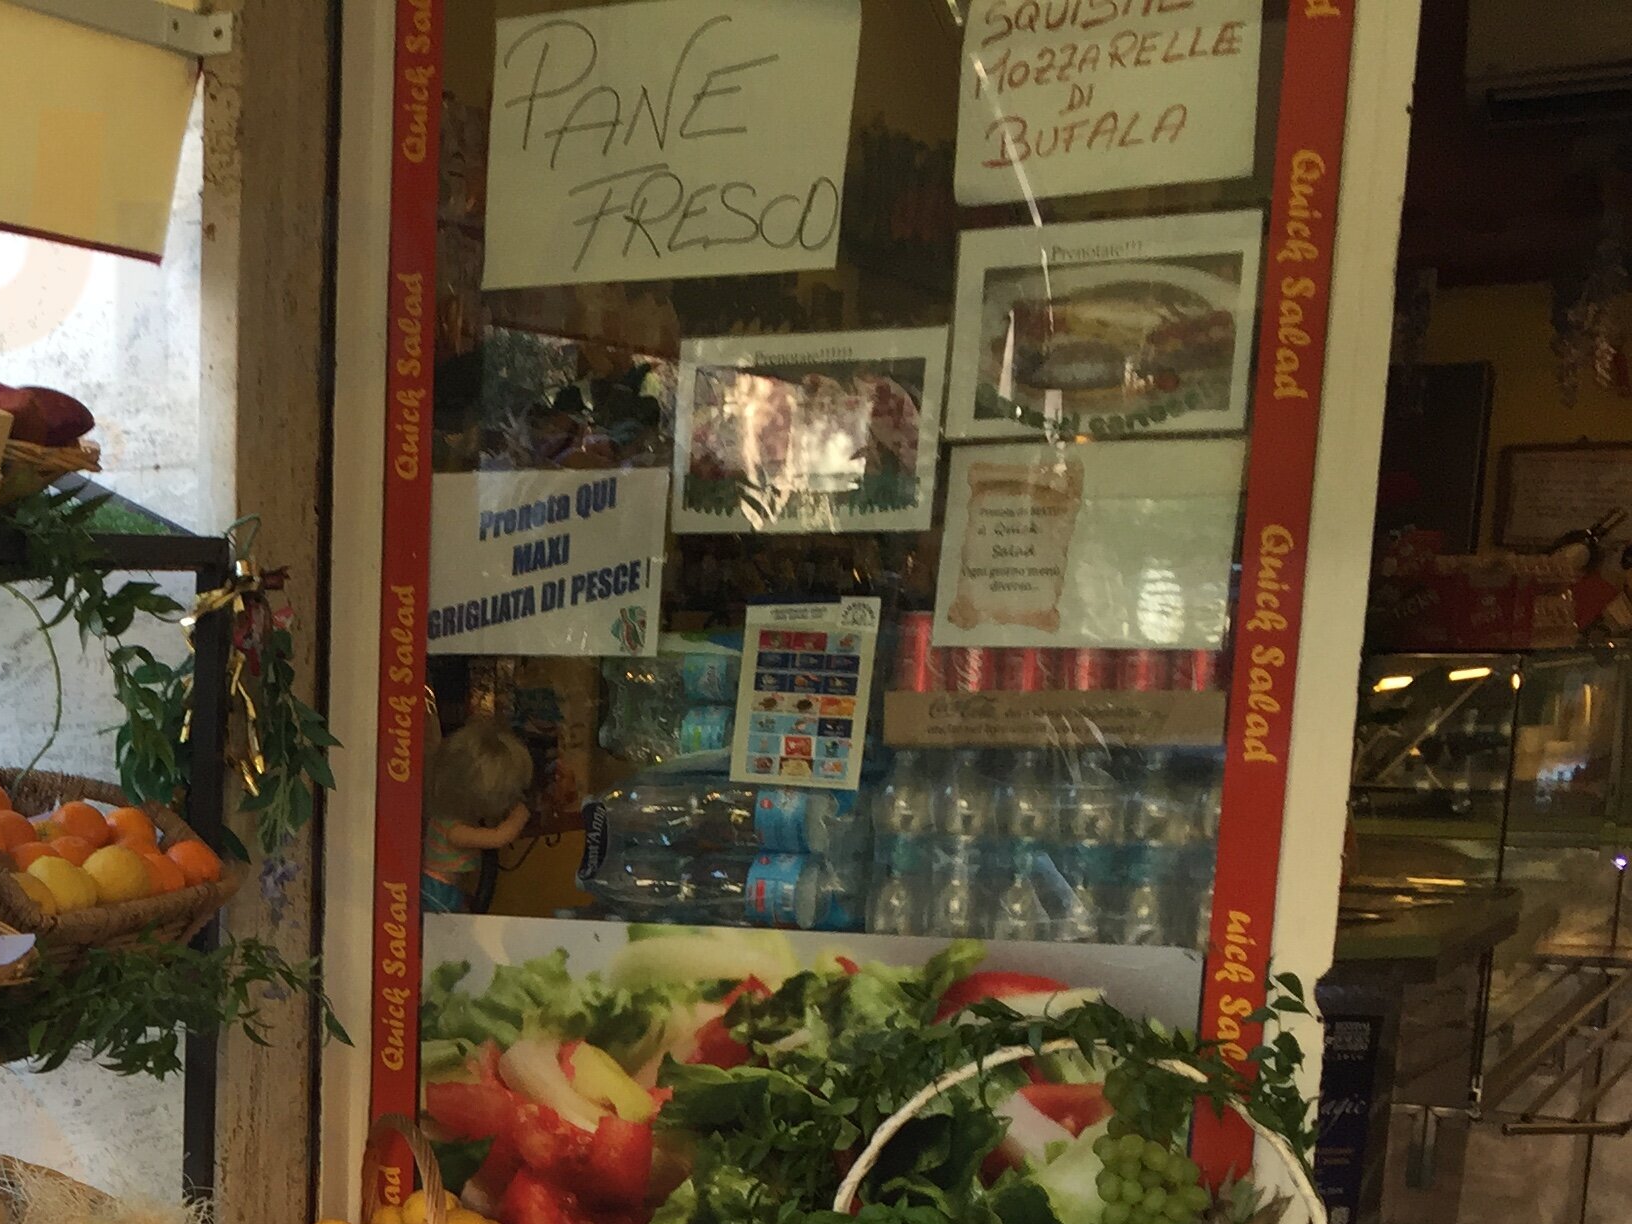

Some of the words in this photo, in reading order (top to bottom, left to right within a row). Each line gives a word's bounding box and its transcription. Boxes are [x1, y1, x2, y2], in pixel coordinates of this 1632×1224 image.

[503, 15, 779, 169] PANE
[975, 21, 1246, 100] MOZZARELLE
[1058, 82, 1095, 116] DI
[402, 64, 435, 164] Quick
[981, 102, 1188, 169] BUFALA
[568, 162, 838, 272] FRESCO
[1275, 148, 1327, 264] Quick
[396, 271, 424, 378] Salad
[1273, 275, 1317, 402] Salad
[394, 387, 426, 481] Quick
[575, 477, 616, 519] QUI
[511, 533, 570, 576] MAXI
[1246, 523, 1294, 636] Quick
[389, 584, 416, 683] Salad
[427, 585, 536, 640] GRIGLIATA
[541, 577, 566, 613] DI
[387, 692, 418, 784] Quick
[1243, 644, 1286, 764] Salad
[382, 879, 409, 974] Salad
[1215, 910, 1257, 984] uick
[380, 986, 412, 1074] Quick
[1217, 994, 1253, 1062] Sal
